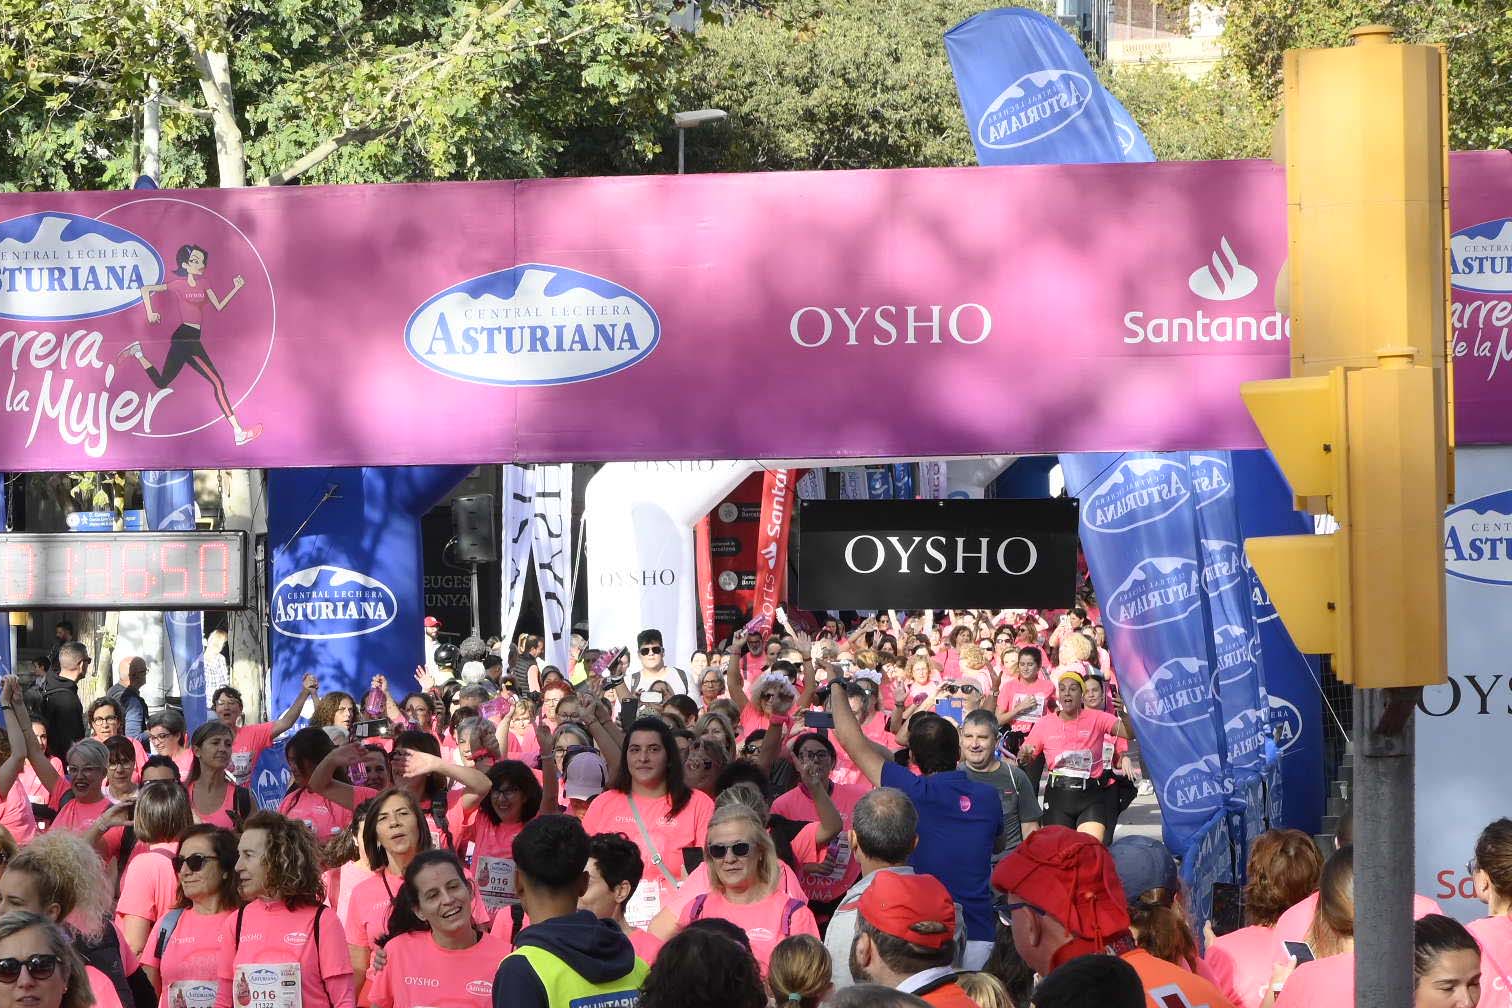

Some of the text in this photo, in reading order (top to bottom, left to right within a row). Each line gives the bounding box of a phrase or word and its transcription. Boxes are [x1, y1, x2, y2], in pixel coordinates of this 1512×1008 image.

[67, 248, 140, 259] LECHERA
[465, 304, 632, 319] CENTRAL LECHERA
[790, 302, 992, 348] OYSHO
[425, 311, 640, 355] ASTURIANA
[5, 372, 30, 412] la
[24, 363, 174, 458] Mujer
[844, 535, 1038, 574] OYSHO
[287, 589, 384, 600] CENTRAL LECHERA
[275, 596, 387, 624] ASTURIANA
[490, 877, 509, 886] 016
[405, 976, 439, 987] OYSHO
[252, 990, 276, 1000] 016
